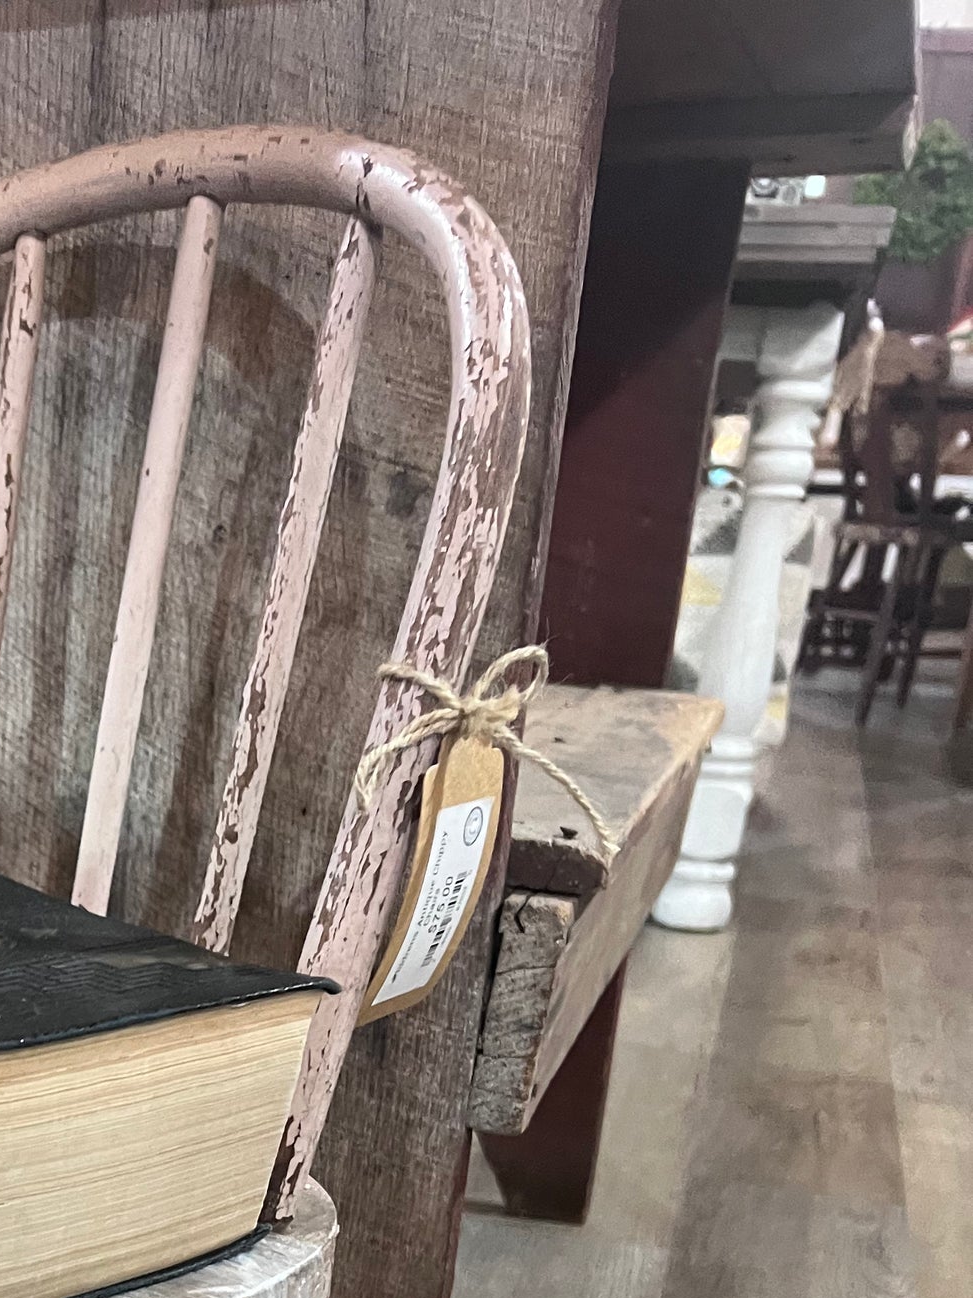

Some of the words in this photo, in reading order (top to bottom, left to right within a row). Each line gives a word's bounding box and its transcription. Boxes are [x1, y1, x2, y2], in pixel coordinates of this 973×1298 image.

[418, 878, 436, 927] Antique
[432, 830, 449, 876] Chippy
[423, 887, 441, 927] Chairs
